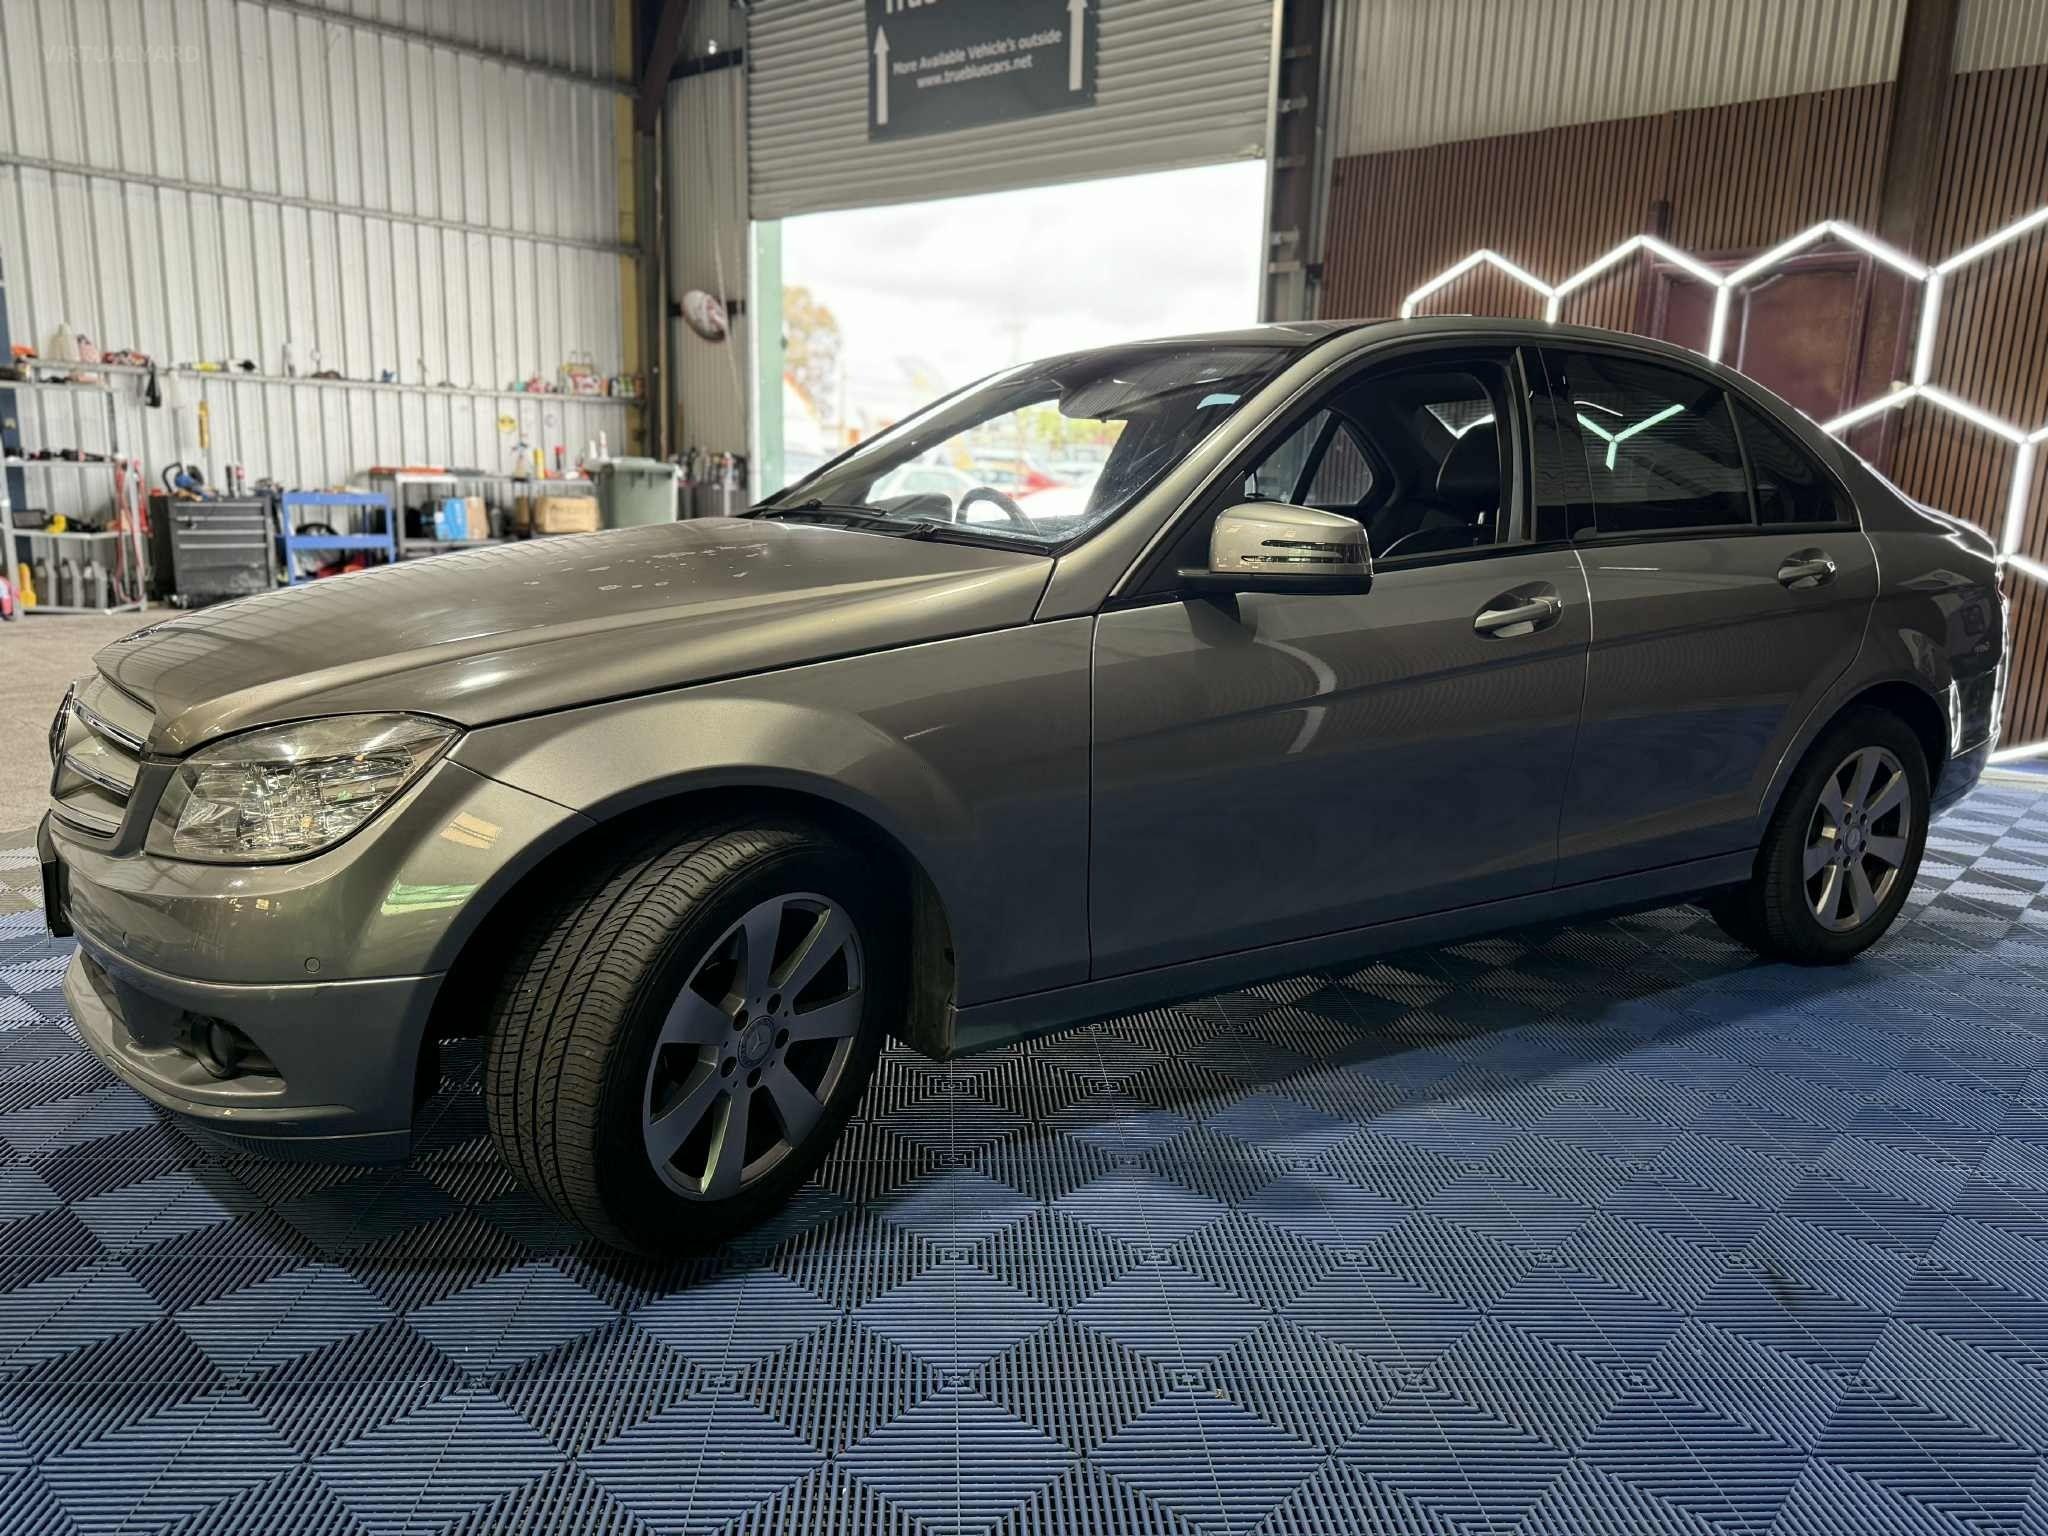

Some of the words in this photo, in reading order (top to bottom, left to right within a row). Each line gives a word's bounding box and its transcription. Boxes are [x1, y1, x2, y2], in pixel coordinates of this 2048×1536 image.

[893, 60, 918, 75] More
[919, 48, 966, 69] Available
[967, 38, 1017, 60] Vehicle's
[1018, 29, 1063, 50] outside
[916, 54, 1033, 89] www.truebluecars.net
